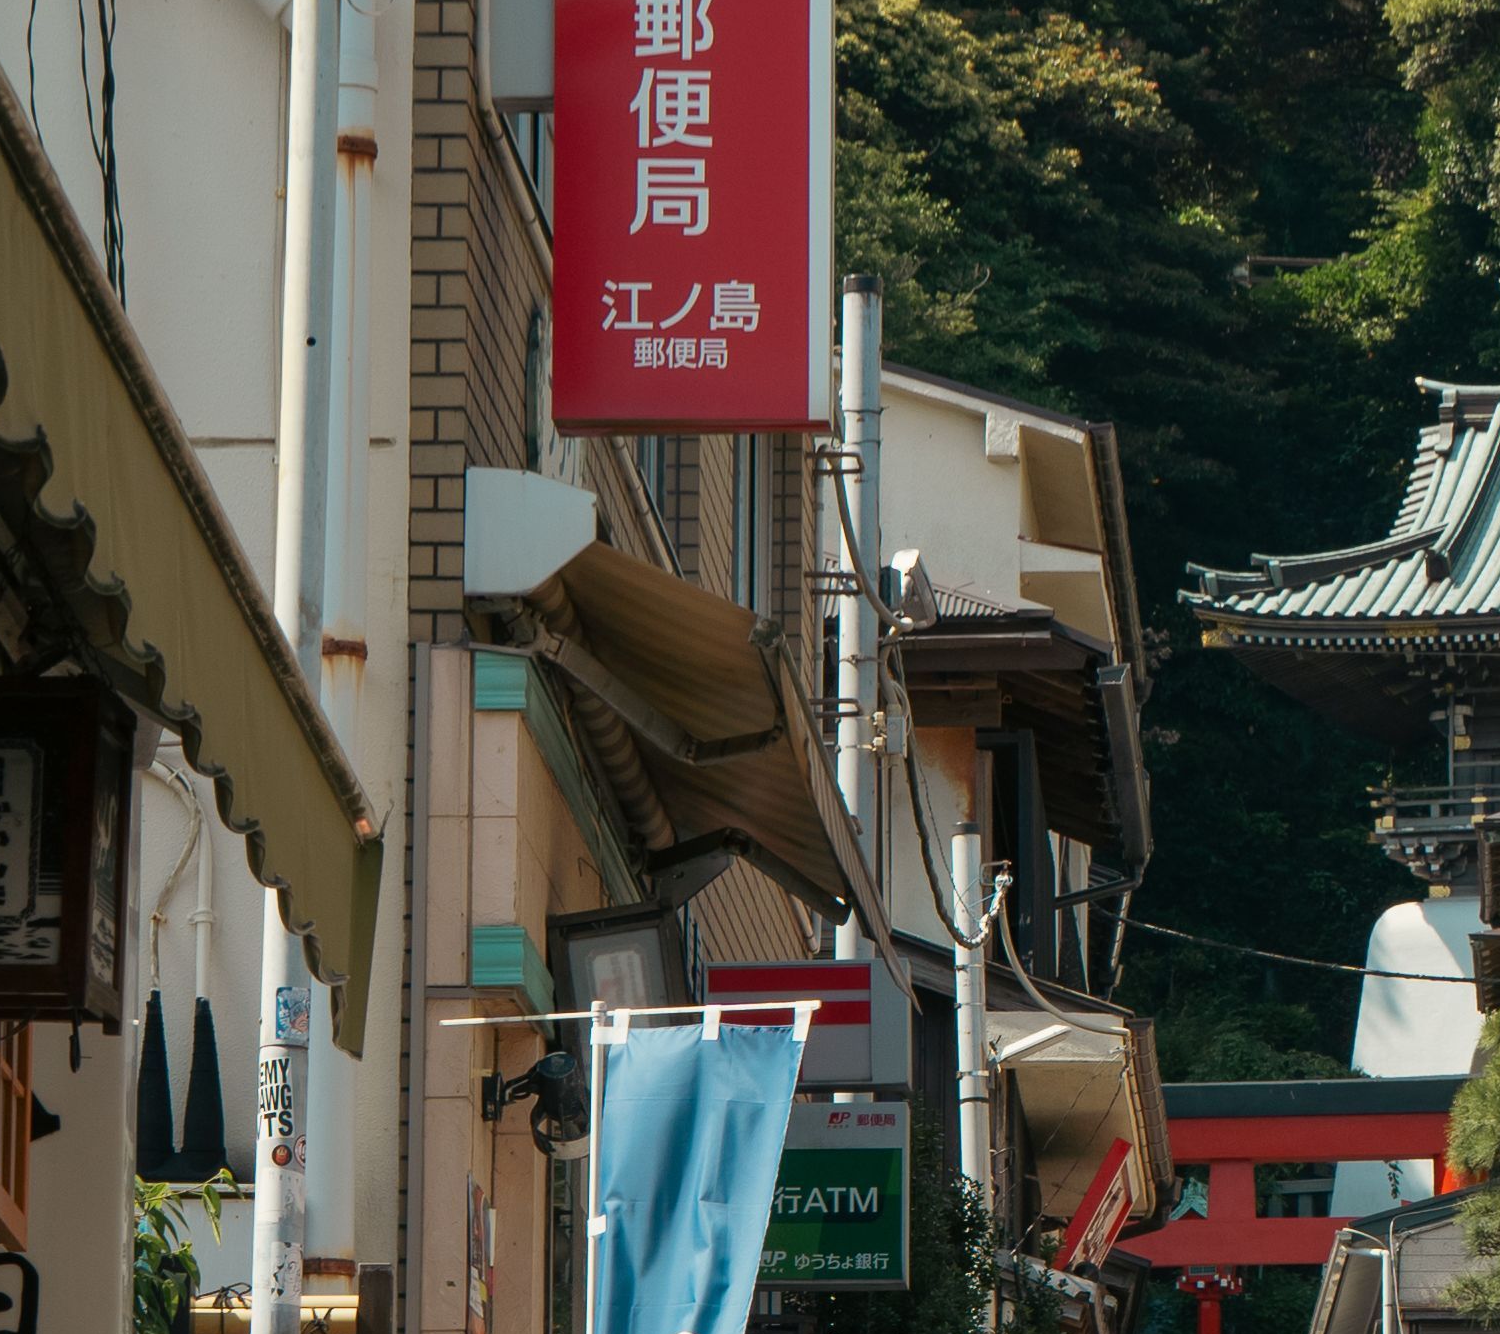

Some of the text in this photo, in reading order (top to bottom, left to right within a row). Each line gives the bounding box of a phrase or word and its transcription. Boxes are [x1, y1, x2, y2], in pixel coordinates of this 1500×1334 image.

[601, 279, 762, 333] 江ノ島
[633, 336, 729, 370] 郵便局
[857, 1113, 896, 1127] 郵便局
[794, 1252, 890, 1270] ゆうちょ銀行
